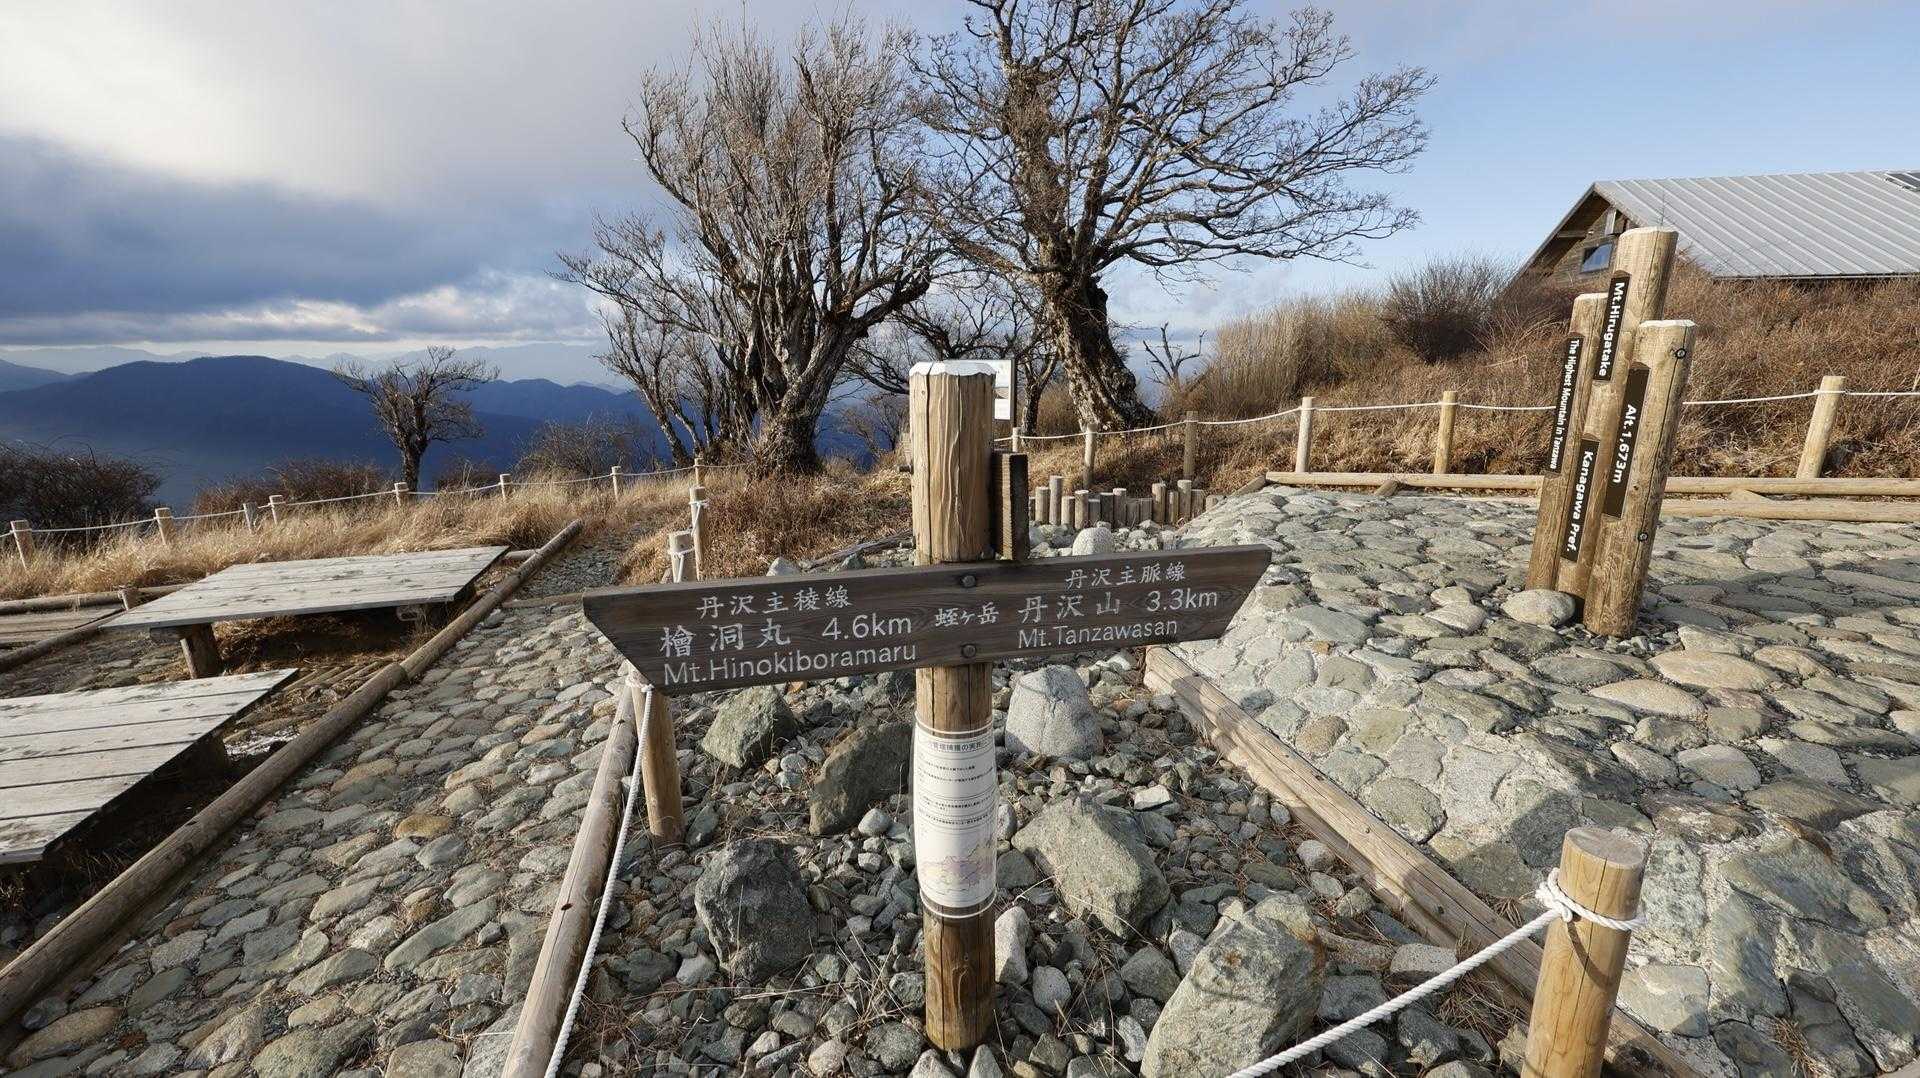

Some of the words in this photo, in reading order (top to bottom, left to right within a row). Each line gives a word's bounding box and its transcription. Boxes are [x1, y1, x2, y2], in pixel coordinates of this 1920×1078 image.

[1597, 282, 1624, 377] Mt.Hirugatake
[1567, 340, 1579, 355] The
[1562, 356, 1576, 386] Highest
[1556, 387, 1571, 426] Mountain
[1554, 427, 1564, 435] in
[1549, 436, 1563, 469] Tanzawa
[1571, 451, 1593, 519] Kanagawa
[1566, 523, 1580, 553] Pref.
[1066, 562, 1186, 589] 丹沢主脈線
[697, 586, 852, 619] 丹沢主稜線
[1018, 594, 1120, 623] 丹沢山
[1146, 588, 1218, 612] 3.3km
[659, 619, 790, 657] 檜洞丸
[821, 613, 912, 640] 4.6km
[664, 644, 917, 685] Mt.Hinokiboramaru
